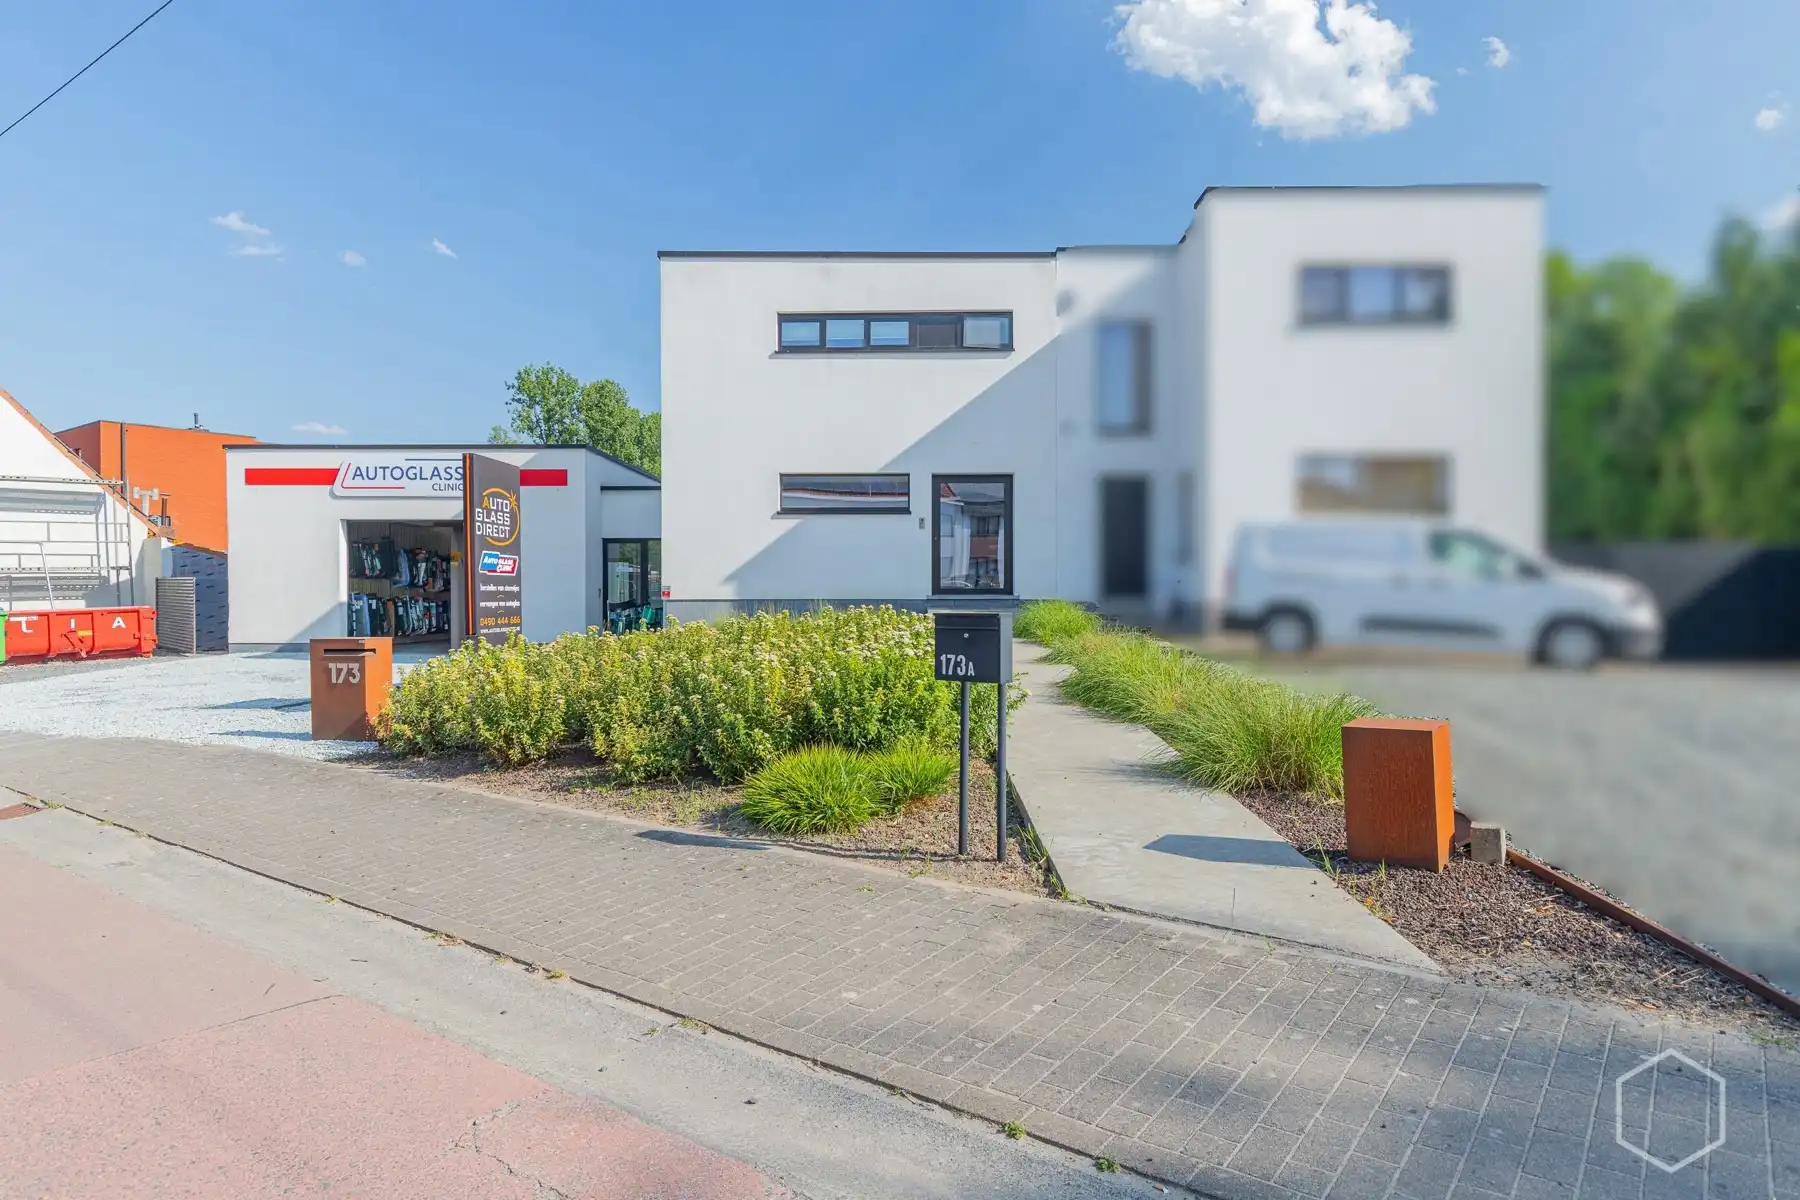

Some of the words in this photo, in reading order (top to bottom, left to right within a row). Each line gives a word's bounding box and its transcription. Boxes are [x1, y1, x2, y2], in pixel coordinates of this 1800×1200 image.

[352, 466, 464, 481] AUTOGLASS
[432, 483, 464, 492] CLINIC
[482, 495, 510, 512] AUTO
[475, 508, 510, 525] GLASS
[475, 522, 510, 538] DIRECT
[480, 616, 496, 626] 0490
[498, 616, 508, 624] 444
[328, 662, 361, 684] 173
